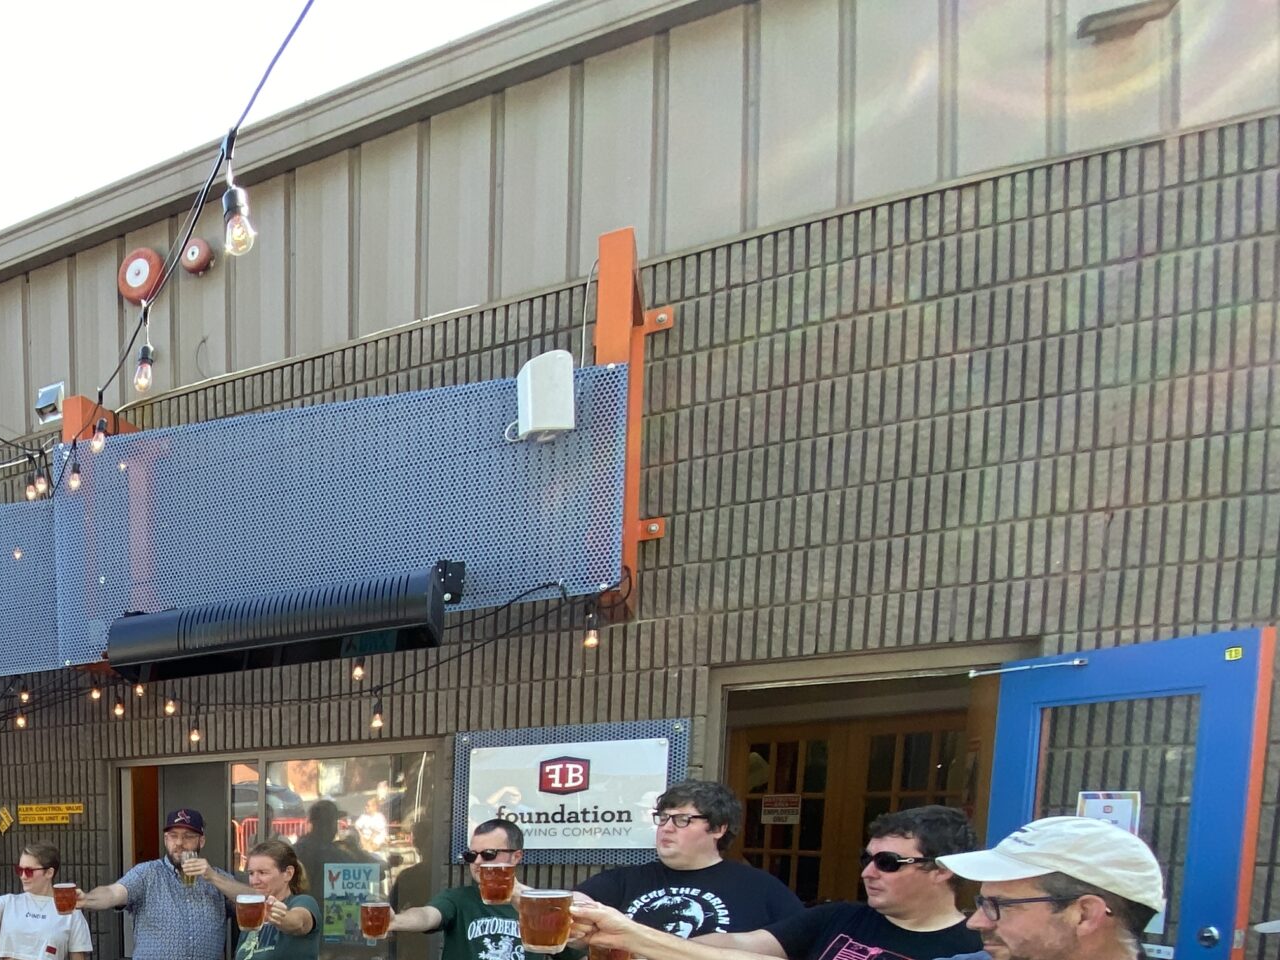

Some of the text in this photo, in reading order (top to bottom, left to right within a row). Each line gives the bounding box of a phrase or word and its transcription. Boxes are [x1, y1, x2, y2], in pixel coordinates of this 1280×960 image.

[496, 803, 632, 824] foundation
[522, 827, 632, 838] WING COMPANY
[342, 868, 373, 881] BUY
[625, 886, 731, 926] SSACRE THE BRIAN
[467, 917, 522, 941] OKTOBER
